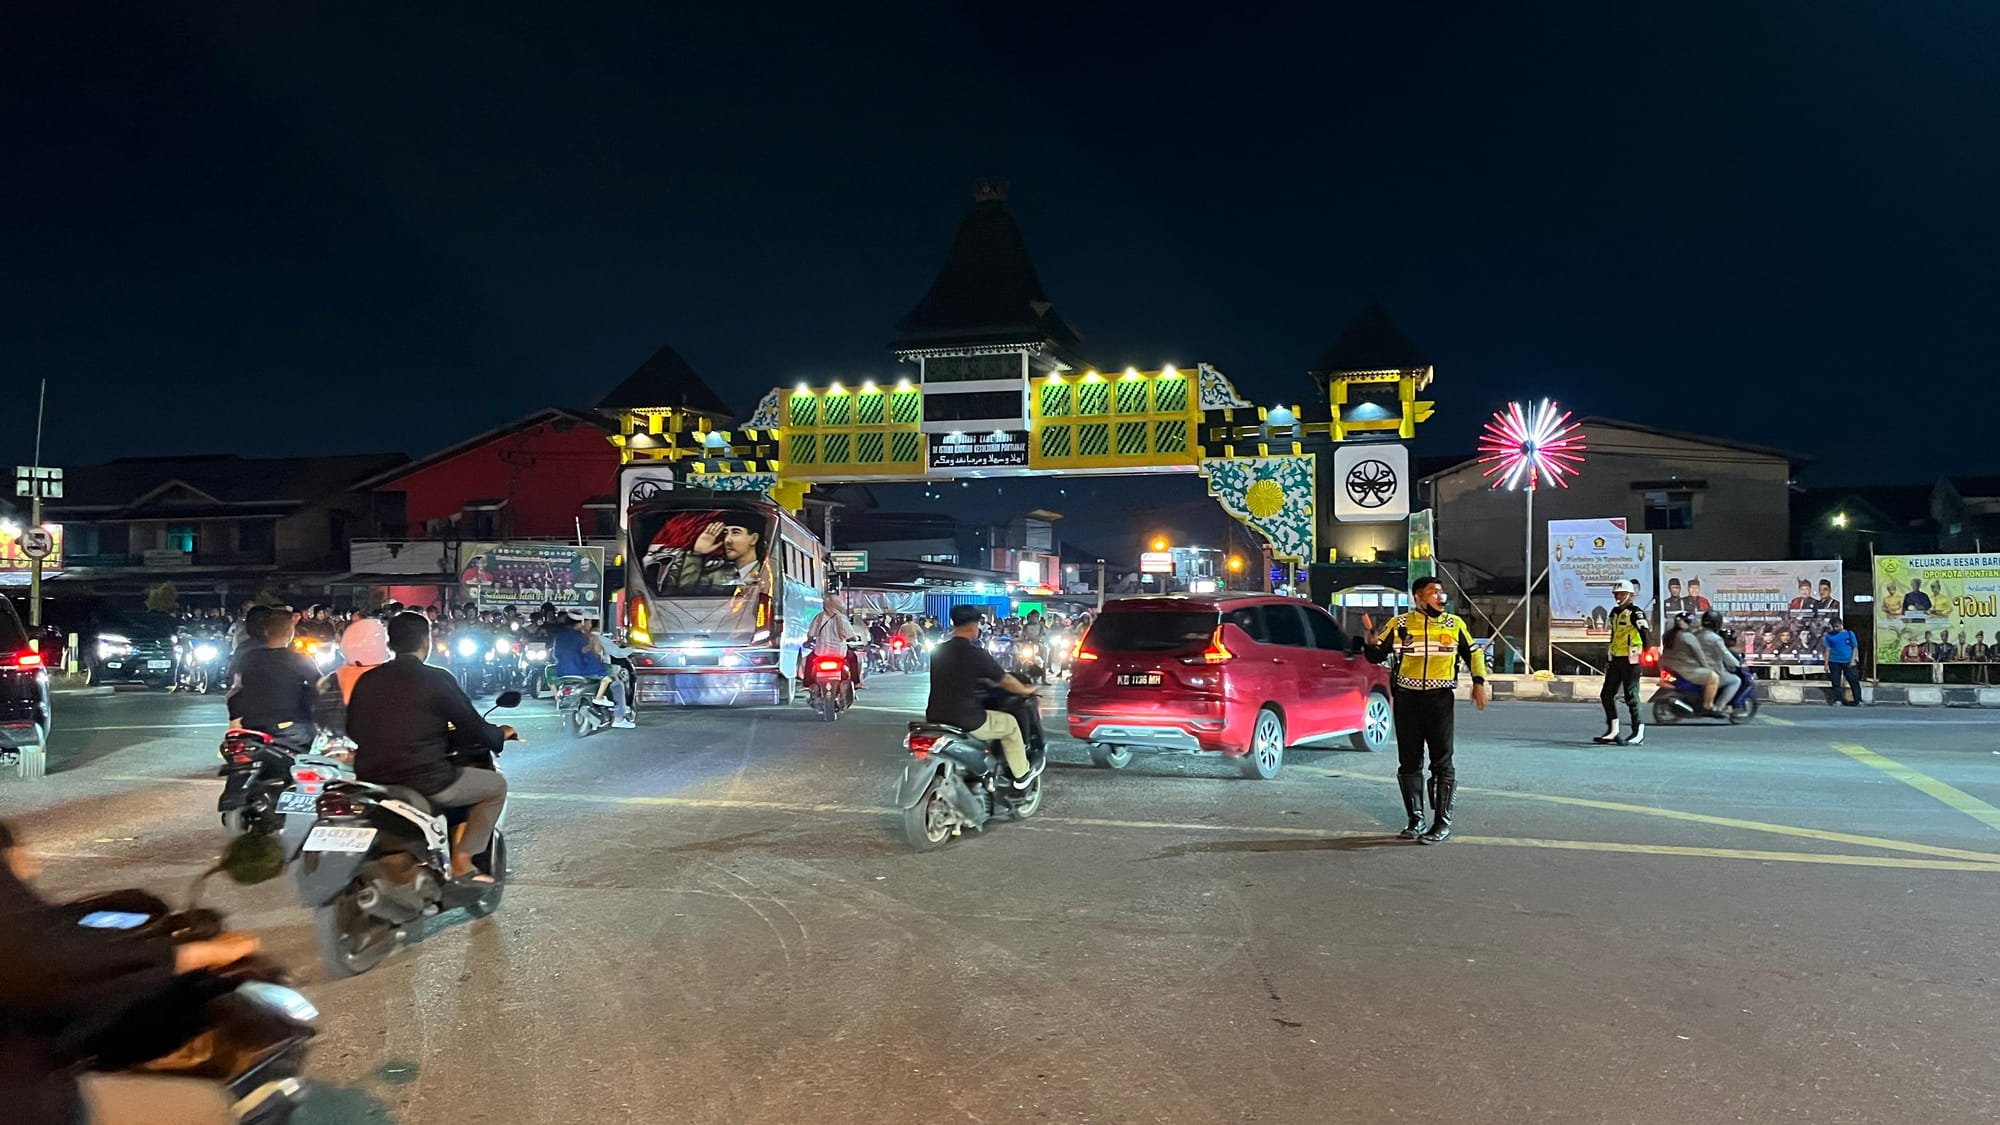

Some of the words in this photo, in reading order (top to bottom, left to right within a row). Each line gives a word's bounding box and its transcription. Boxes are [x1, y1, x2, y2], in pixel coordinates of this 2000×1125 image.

[1909, 558, 1952, 568] KELUARGA
[1953, 557, 1981, 567] BESAR
[1941, 570, 1963, 578] KOTA
